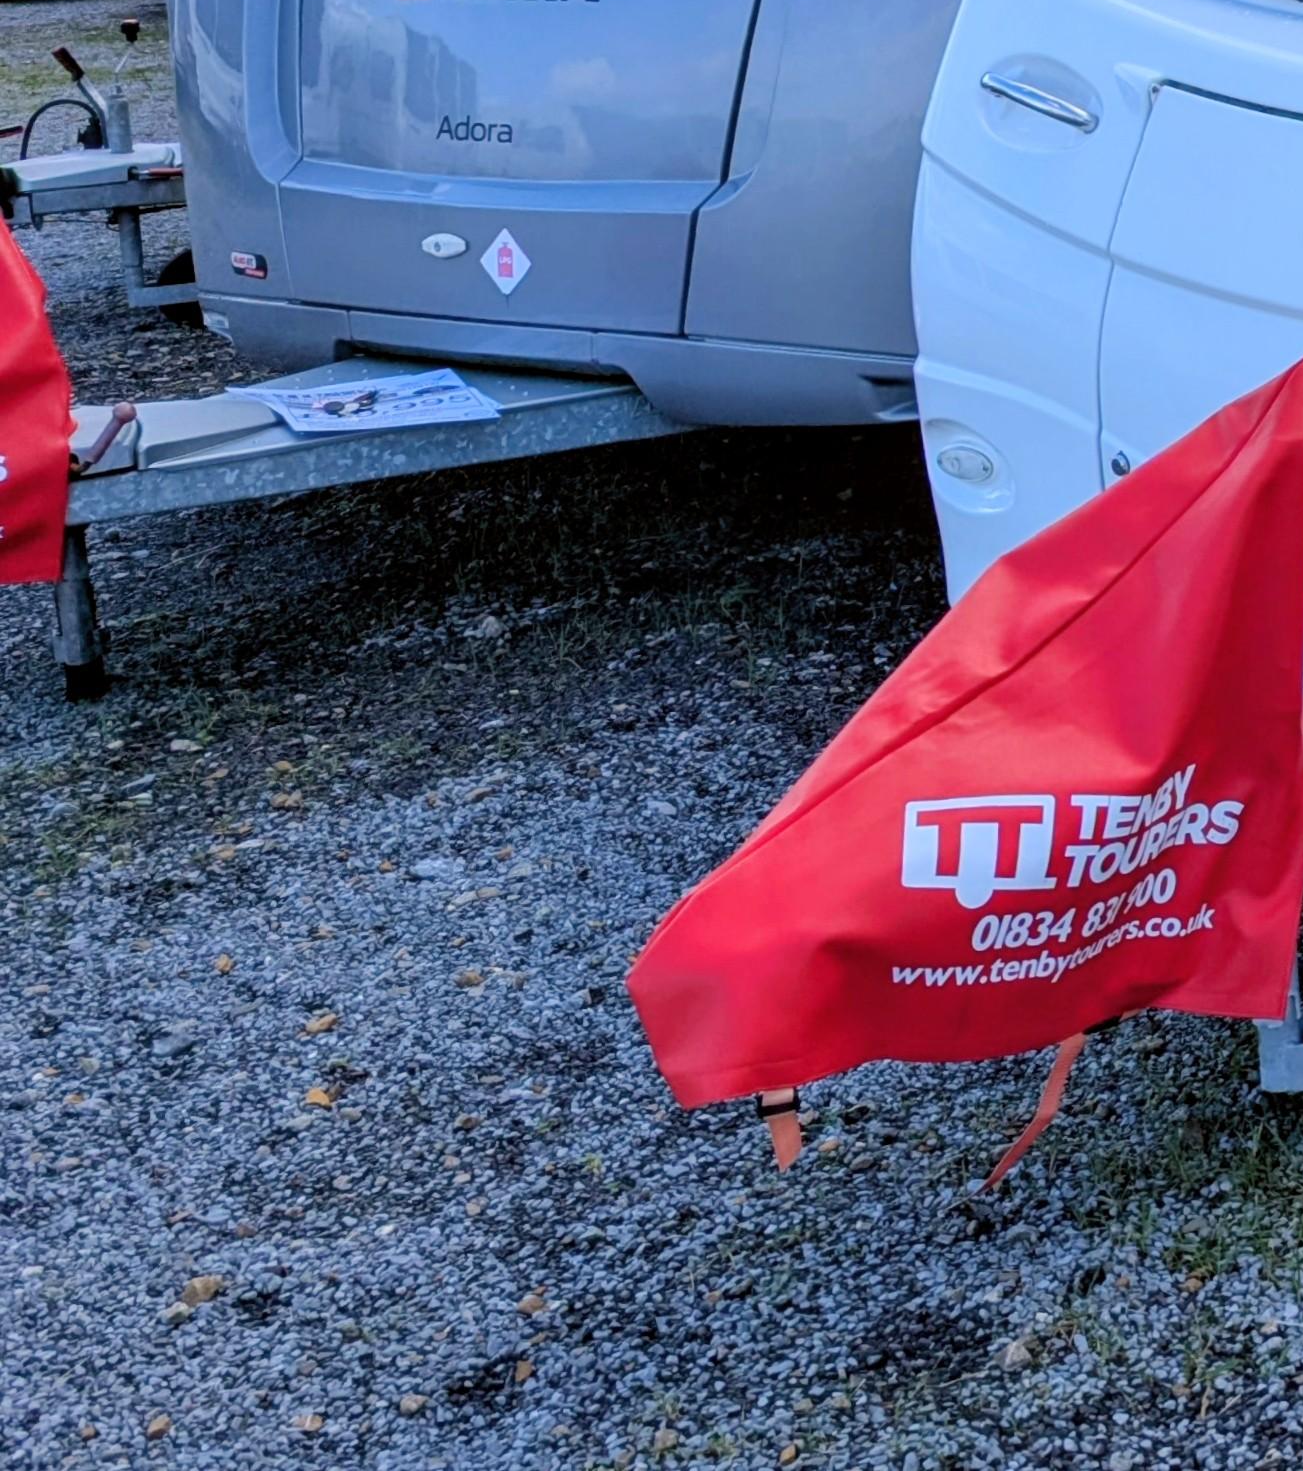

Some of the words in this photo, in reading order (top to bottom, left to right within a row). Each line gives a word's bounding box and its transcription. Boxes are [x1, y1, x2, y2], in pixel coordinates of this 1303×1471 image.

[436, 115, 513, 144] Adora
[1070, 764, 1196, 840] TENBY
[1065, 799, 1245, 888] TOURERS
[891, 902, 1216, 987] www.tenbytourers.co.uk
[971, 908, 1077, 952] 01834
